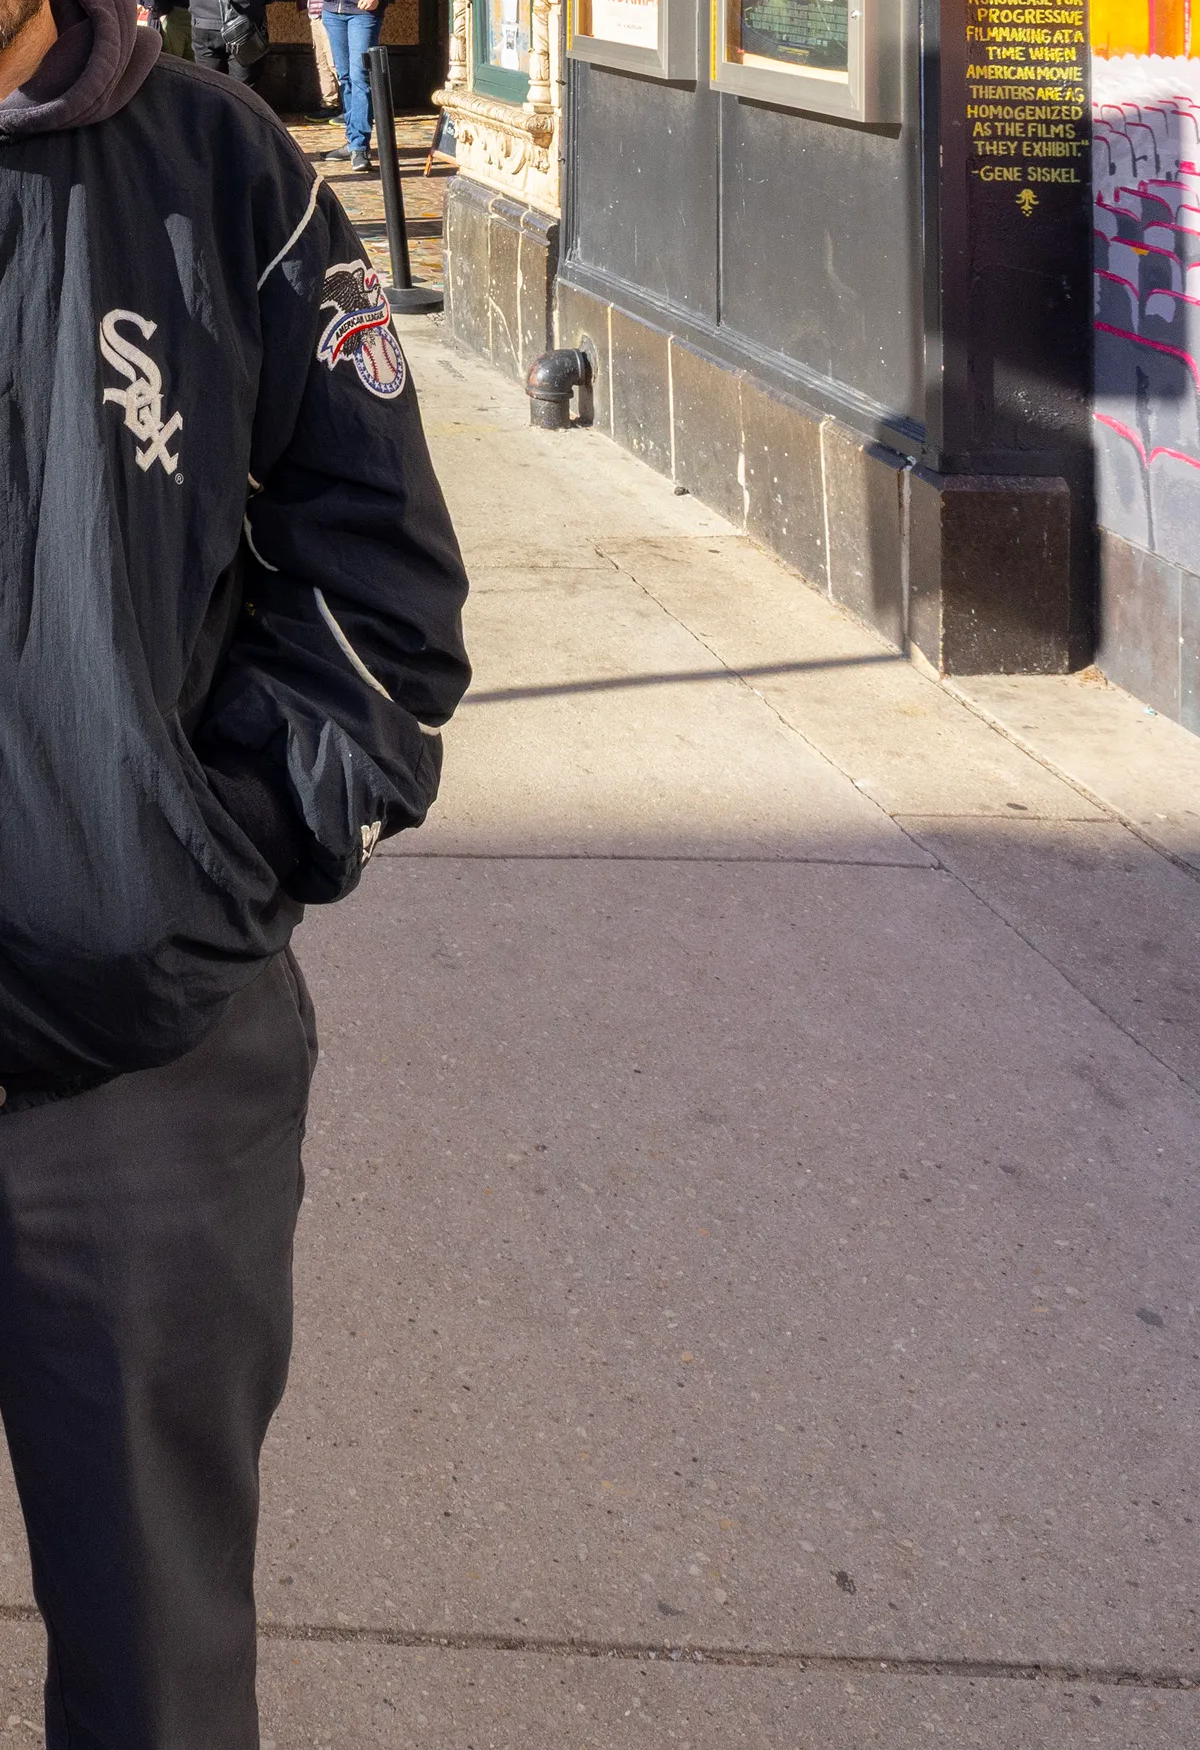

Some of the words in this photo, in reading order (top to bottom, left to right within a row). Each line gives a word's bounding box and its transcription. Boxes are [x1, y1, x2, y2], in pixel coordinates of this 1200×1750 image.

[977, 8, 1084, 25] PROGRESSIVE
[966, 25, 1052, 44] FILMMAKING
[1053, 29, 1073, 43] AT
[1074, 30, 1085, 43] A
[986, 46, 1026, 60] TIME
[1028, 46, 1077, 62] WHEN
[966, 64, 1035, 80] AMERICAN
[1036, 66, 1083, 81] MOVIE
[969, 85, 1035, 101] THEATERS
[1036, 87, 1063, 101] ARE
[1065, 87, 1085, 103] AS
[966, 104, 1083, 120] HOMOGENIZED
[972, 122, 992, 137] AS
[994, 122, 1026, 137] THE
[1027, 122, 1076, 139] FILMS
[973, 140, 1018, 156] THEY
[1027, 166, 1081, 183] SISKEL
[335, 316, 365, 341] AMERICAN
[364, 311, 385, 322] LEAGUE
